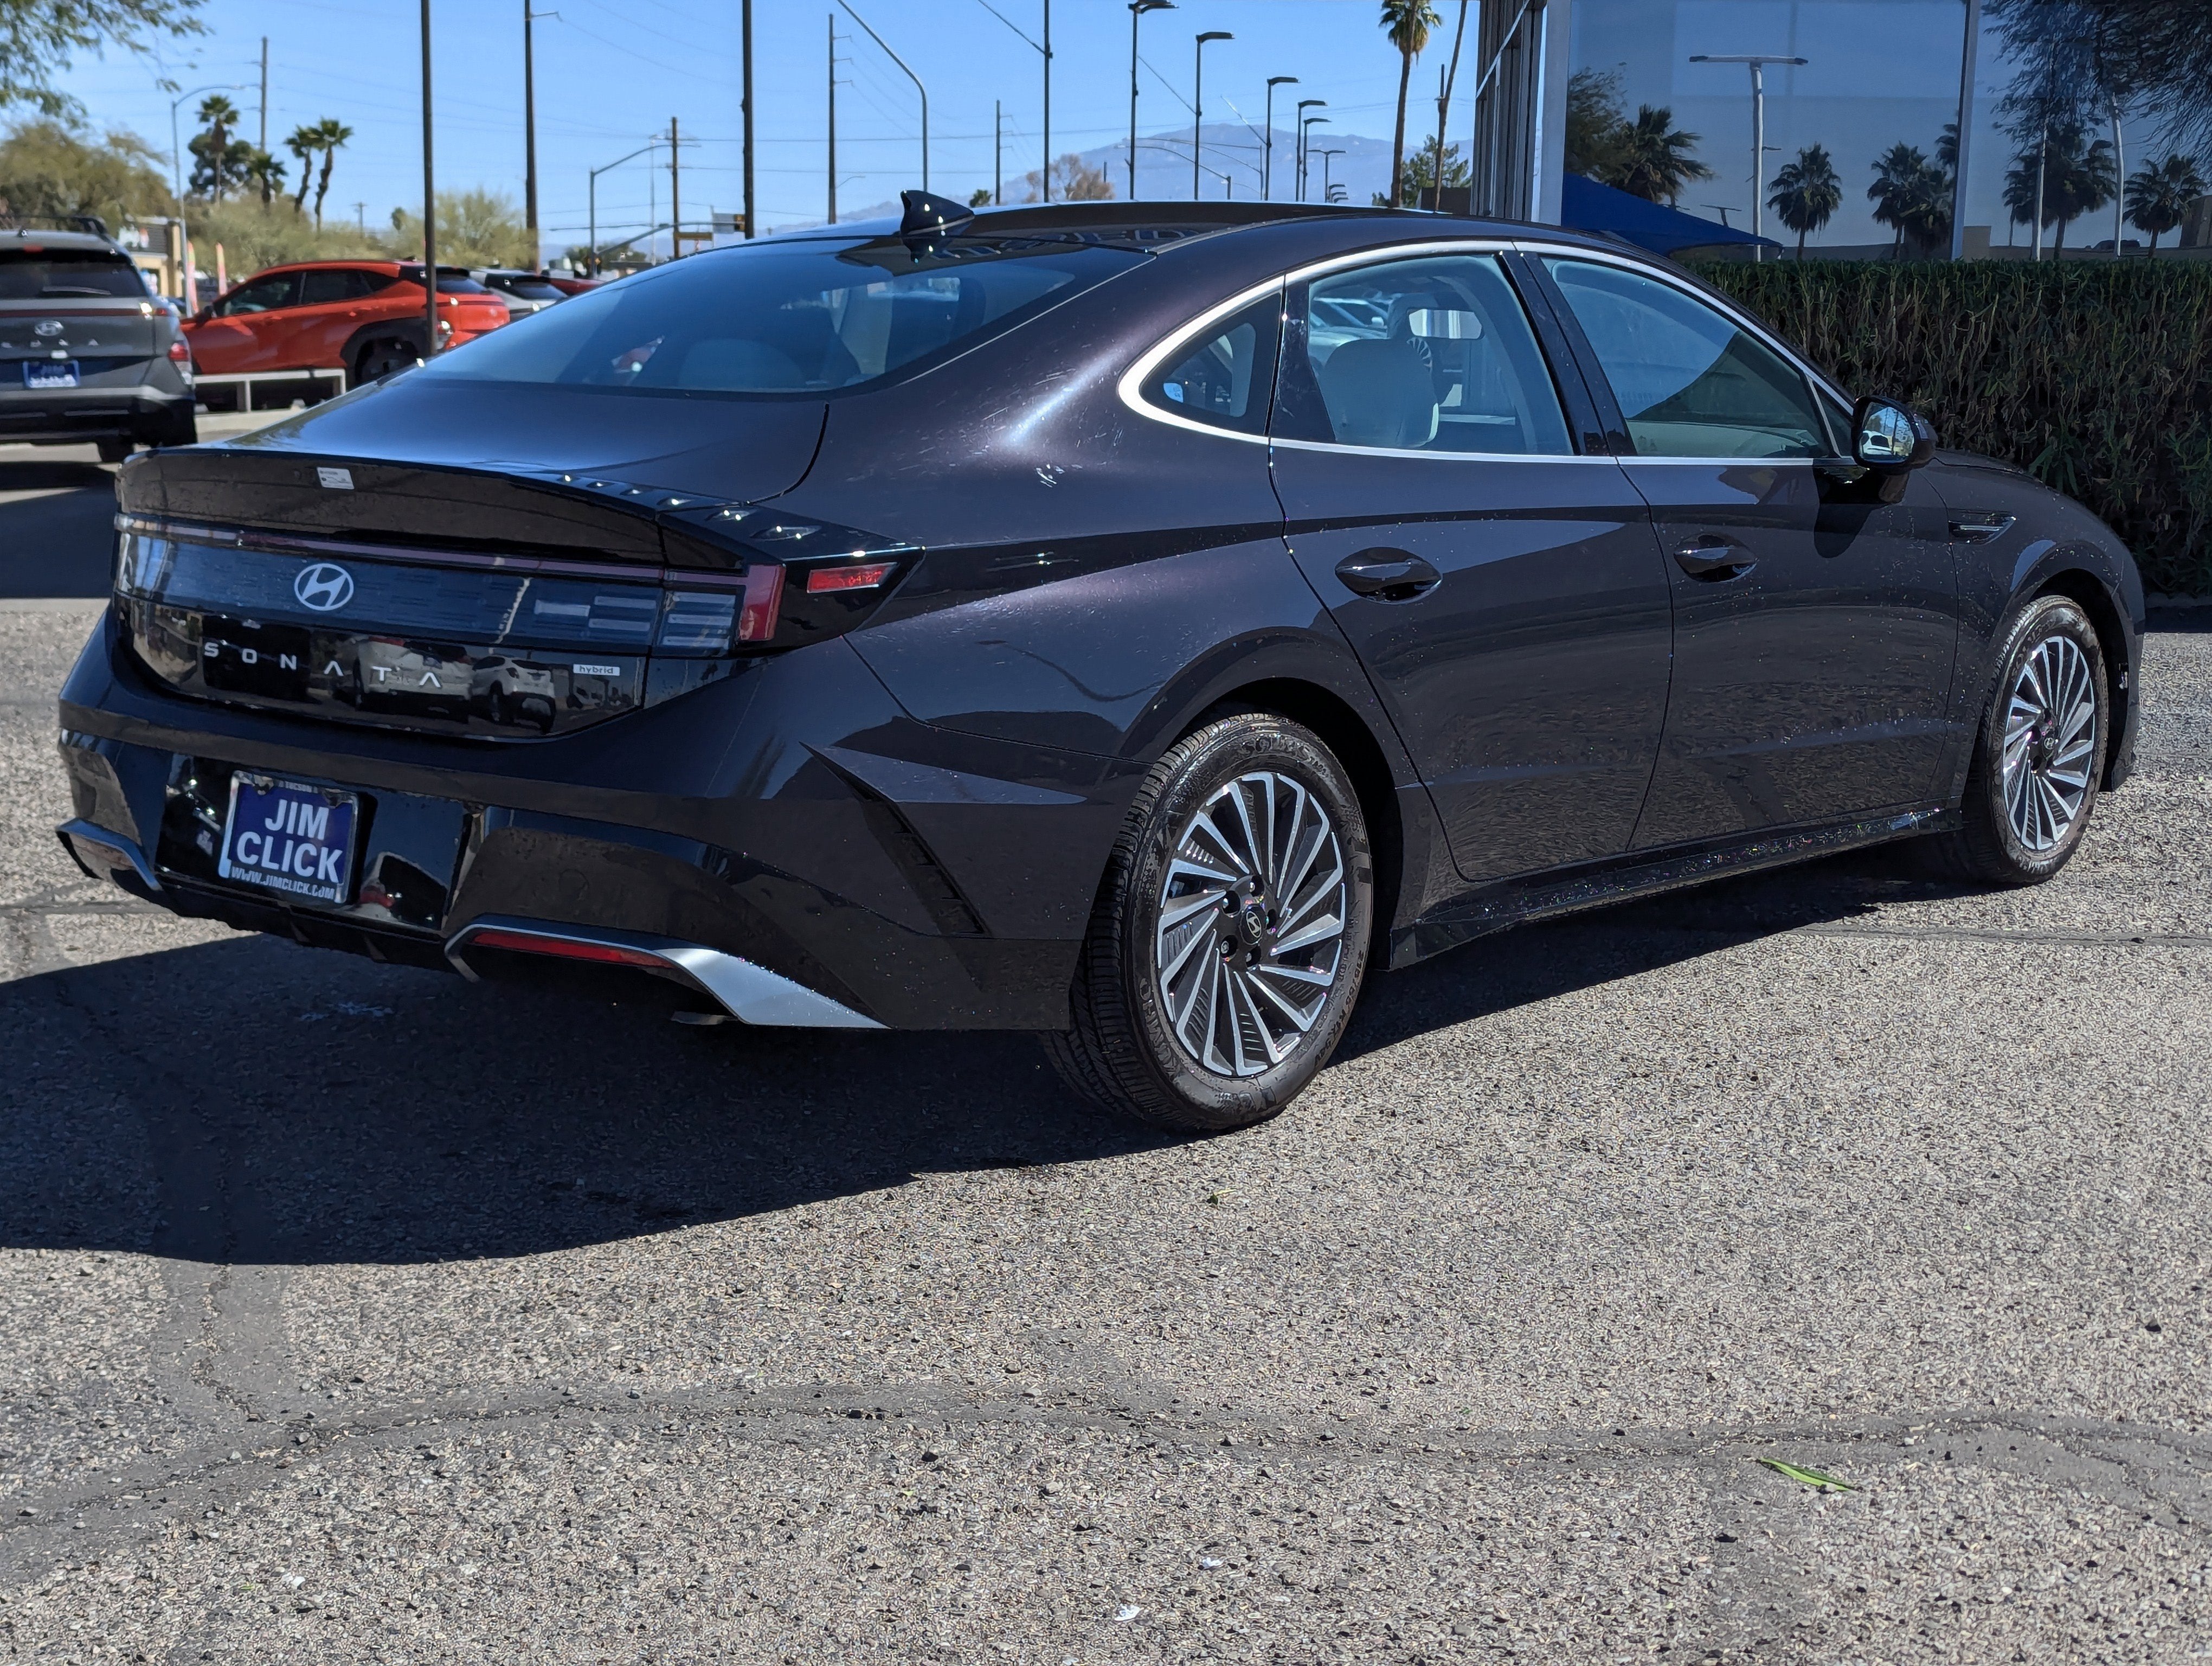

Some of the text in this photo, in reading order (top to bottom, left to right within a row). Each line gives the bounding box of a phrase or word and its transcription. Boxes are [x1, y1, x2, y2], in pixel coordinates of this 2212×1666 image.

[204, 642, 441, 688] SONATA
[579, 665, 614, 674] hybrid
[265, 799, 329, 840] JIM
[237, 831, 343, 883] CLICK
[232, 866, 335, 899] WWW.JIMCLICK.COM
